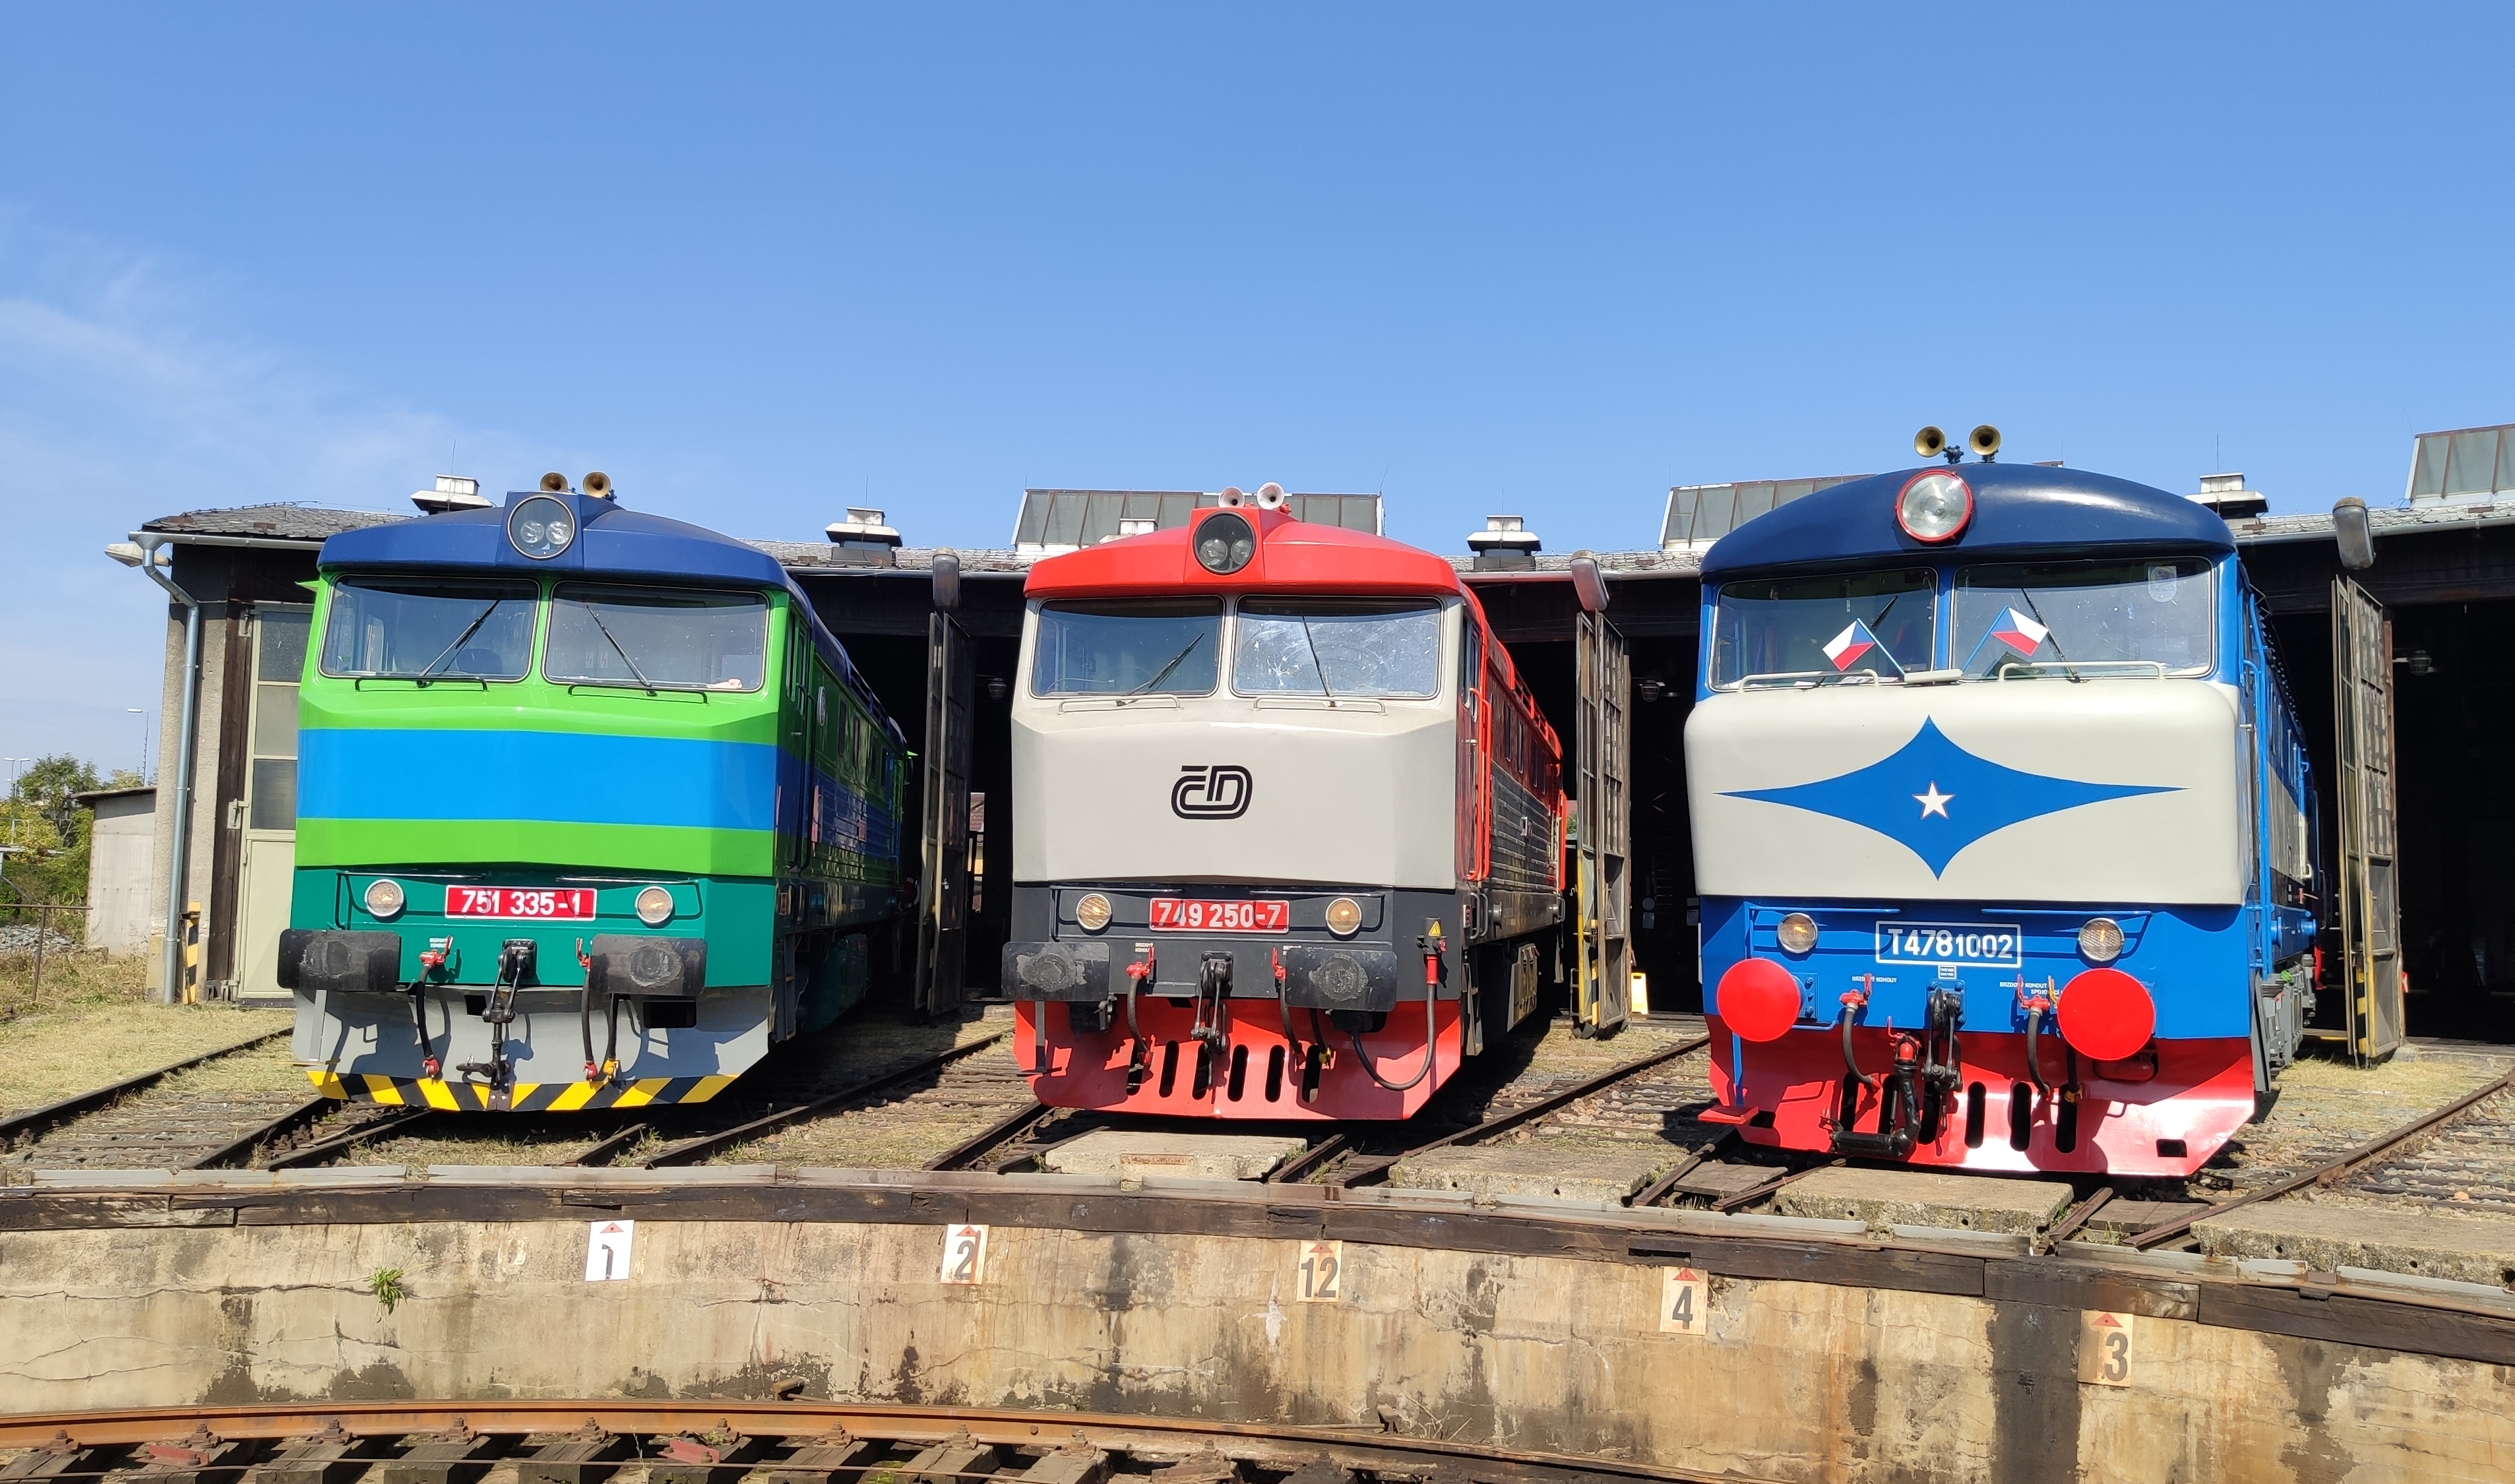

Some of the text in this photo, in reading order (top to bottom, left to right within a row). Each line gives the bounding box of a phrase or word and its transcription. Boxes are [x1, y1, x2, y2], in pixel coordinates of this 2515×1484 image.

[462, 890, 581, 915] 751 335-1
[1158, 902, 1282, 929] 749 250-7
[602, 1243, 614, 1277] 1
[954, 1240, 976, 1280] 2
[1300, 1256, 1338, 1298] 12
[1671, 1285, 1693, 1330] 4
[2104, 1331, 2128, 1382] 3
